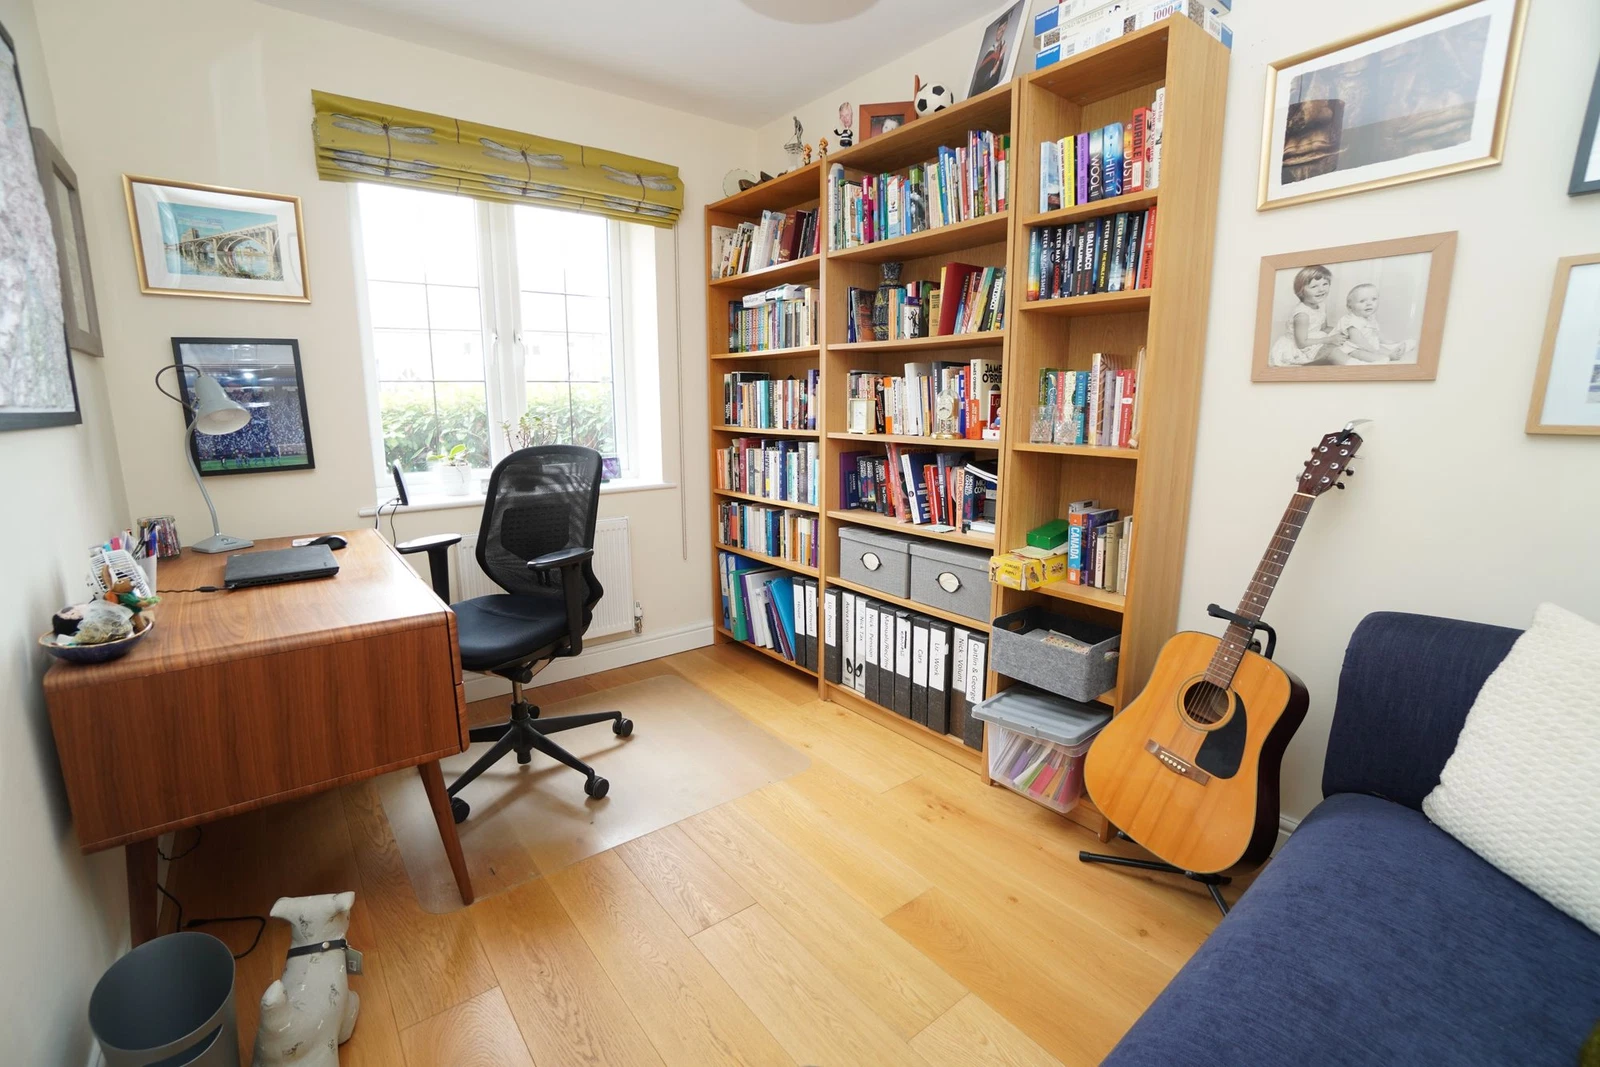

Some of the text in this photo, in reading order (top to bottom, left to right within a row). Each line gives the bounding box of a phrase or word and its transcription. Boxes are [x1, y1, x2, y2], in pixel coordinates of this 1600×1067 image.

[1153, 5, 1173, 21] 1000
[1133, 113, 1144, 158] MURDLE
[1090, 153, 1100, 191] WOOL
[1104, 152, 1115, 184] SHIFT
[1124, 150, 1133, 182] DUST
[1084, 232, 1094, 270] BALDACCI
[1327, 436, 1351, 446] Feder
[1070, 527, 1080, 559] CANADA
[972, 643, 980, 666] Caitlin
[970, 675, 978, 701] George
